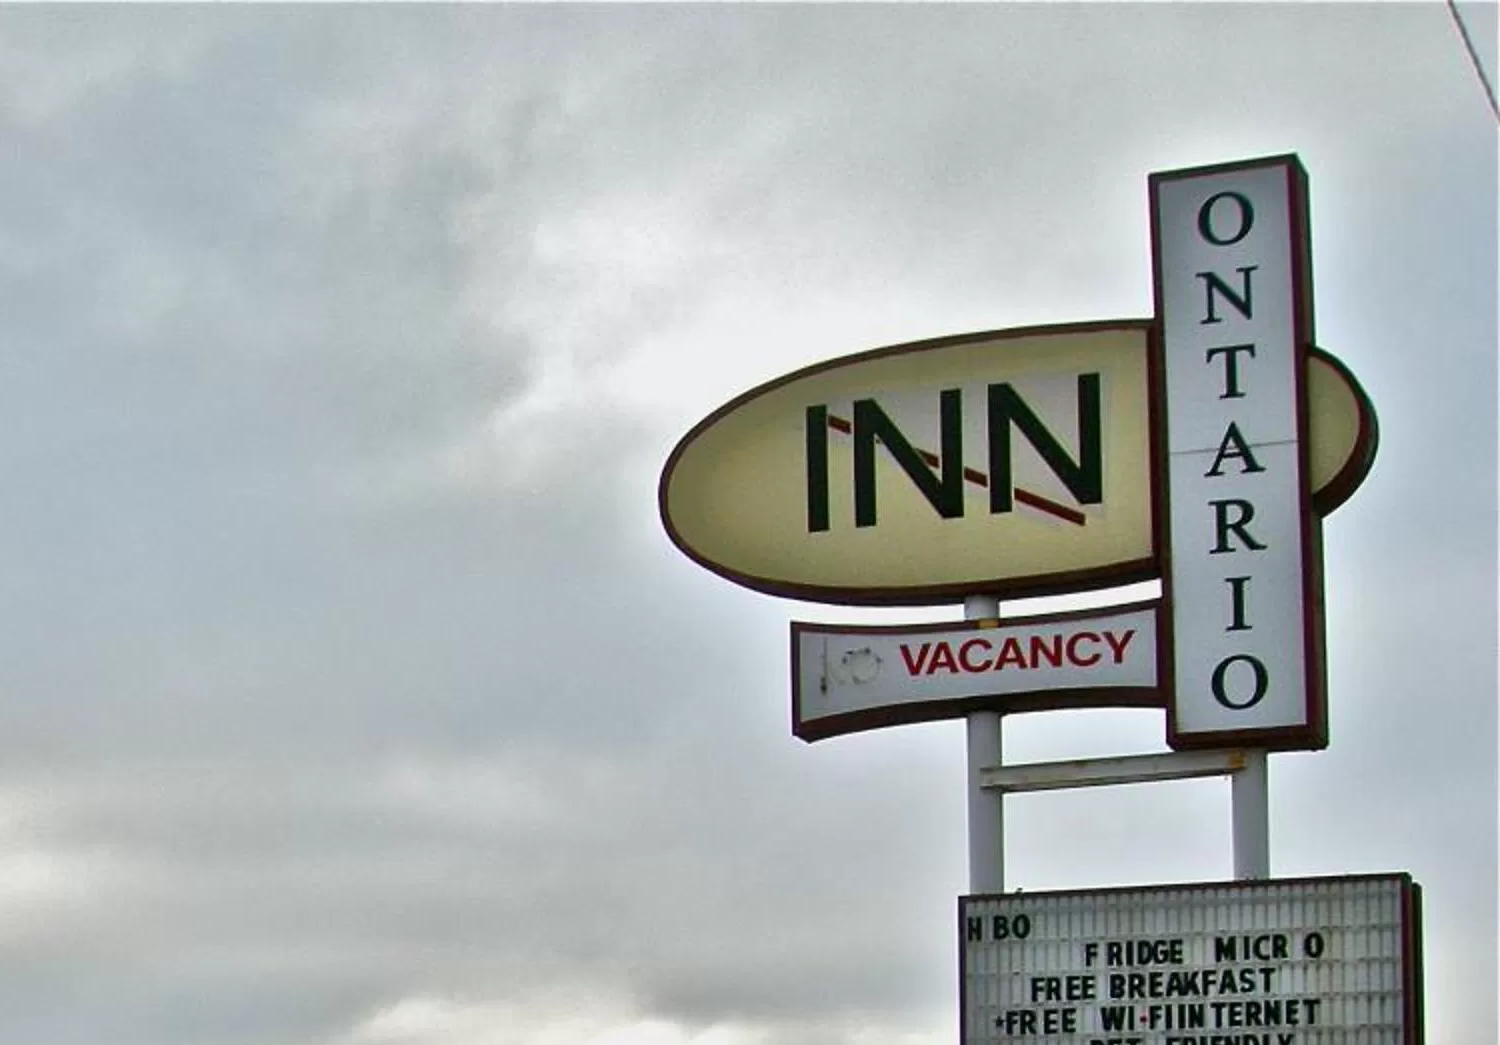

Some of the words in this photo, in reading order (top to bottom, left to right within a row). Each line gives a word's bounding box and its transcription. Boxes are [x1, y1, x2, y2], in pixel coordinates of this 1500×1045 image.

[805, 372, 1103, 533] INN
[1195, 190, 1269, 711] ONTARIO
[900, 629, 1136, 677] VACANCY
[1085, 939, 1184, 967] FRIDGE
[1214, 932, 1325, 963] MICRO
[1031, 975, 1097, 1002] FREE
[1109, 967, 1276, 999] BREAKFAST
